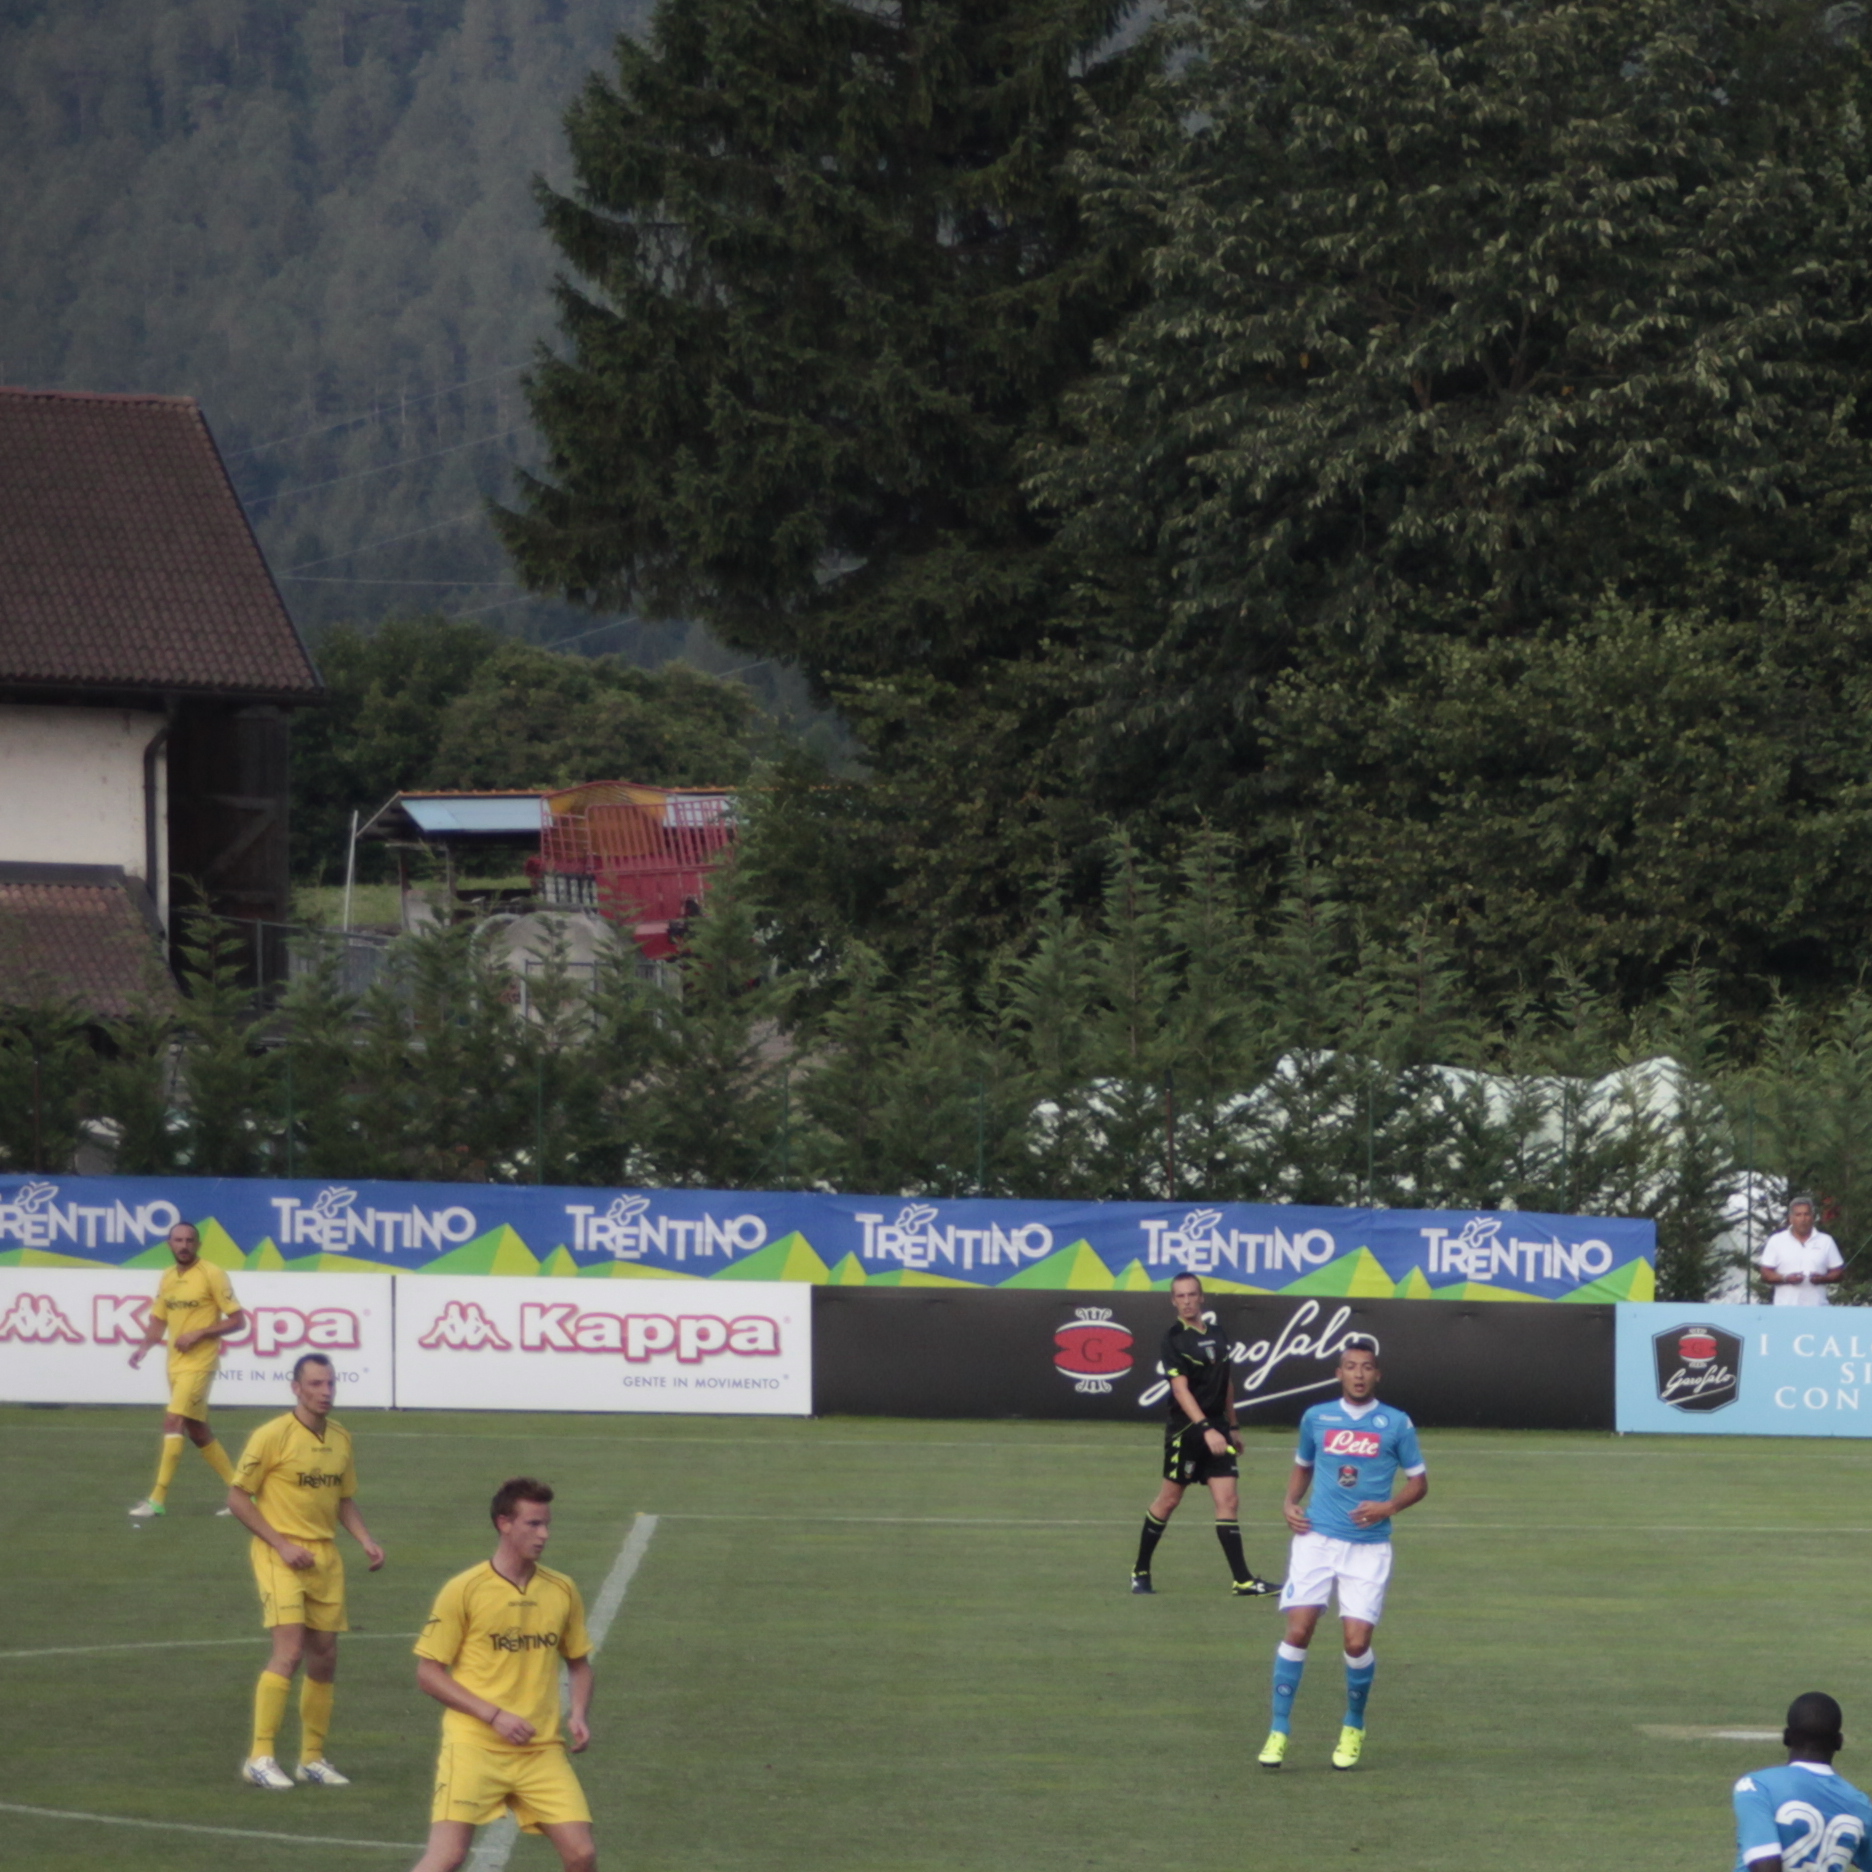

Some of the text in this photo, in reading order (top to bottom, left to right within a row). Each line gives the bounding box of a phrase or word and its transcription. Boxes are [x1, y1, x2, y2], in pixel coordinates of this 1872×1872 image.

[271, 1197, 477, 1253] TRENTINO
[565, 1205, 767, 1261] TRENTINO
[855, 1212, 1053, 1269] TRENTINO
[1140, 1219, 1335, 1274] TRENTINO
[1420, 1227, 1613, 1283] TRENTINO
[519, 1302, 782, 1364] Kappa
[1759, 1334, 1769, 1356] I
[250, 1370, 266, 1381] IN
[622, 1376, 780, 1390] GENTE IN MOVIMENTO
[1840, 1362, 1872, 1385] SI
[1773, 1385, 1861, 1411] CON
[1323, 1430, 1380, 1456] Lete
[489, 1631, 558, 1652] TRENTINO
